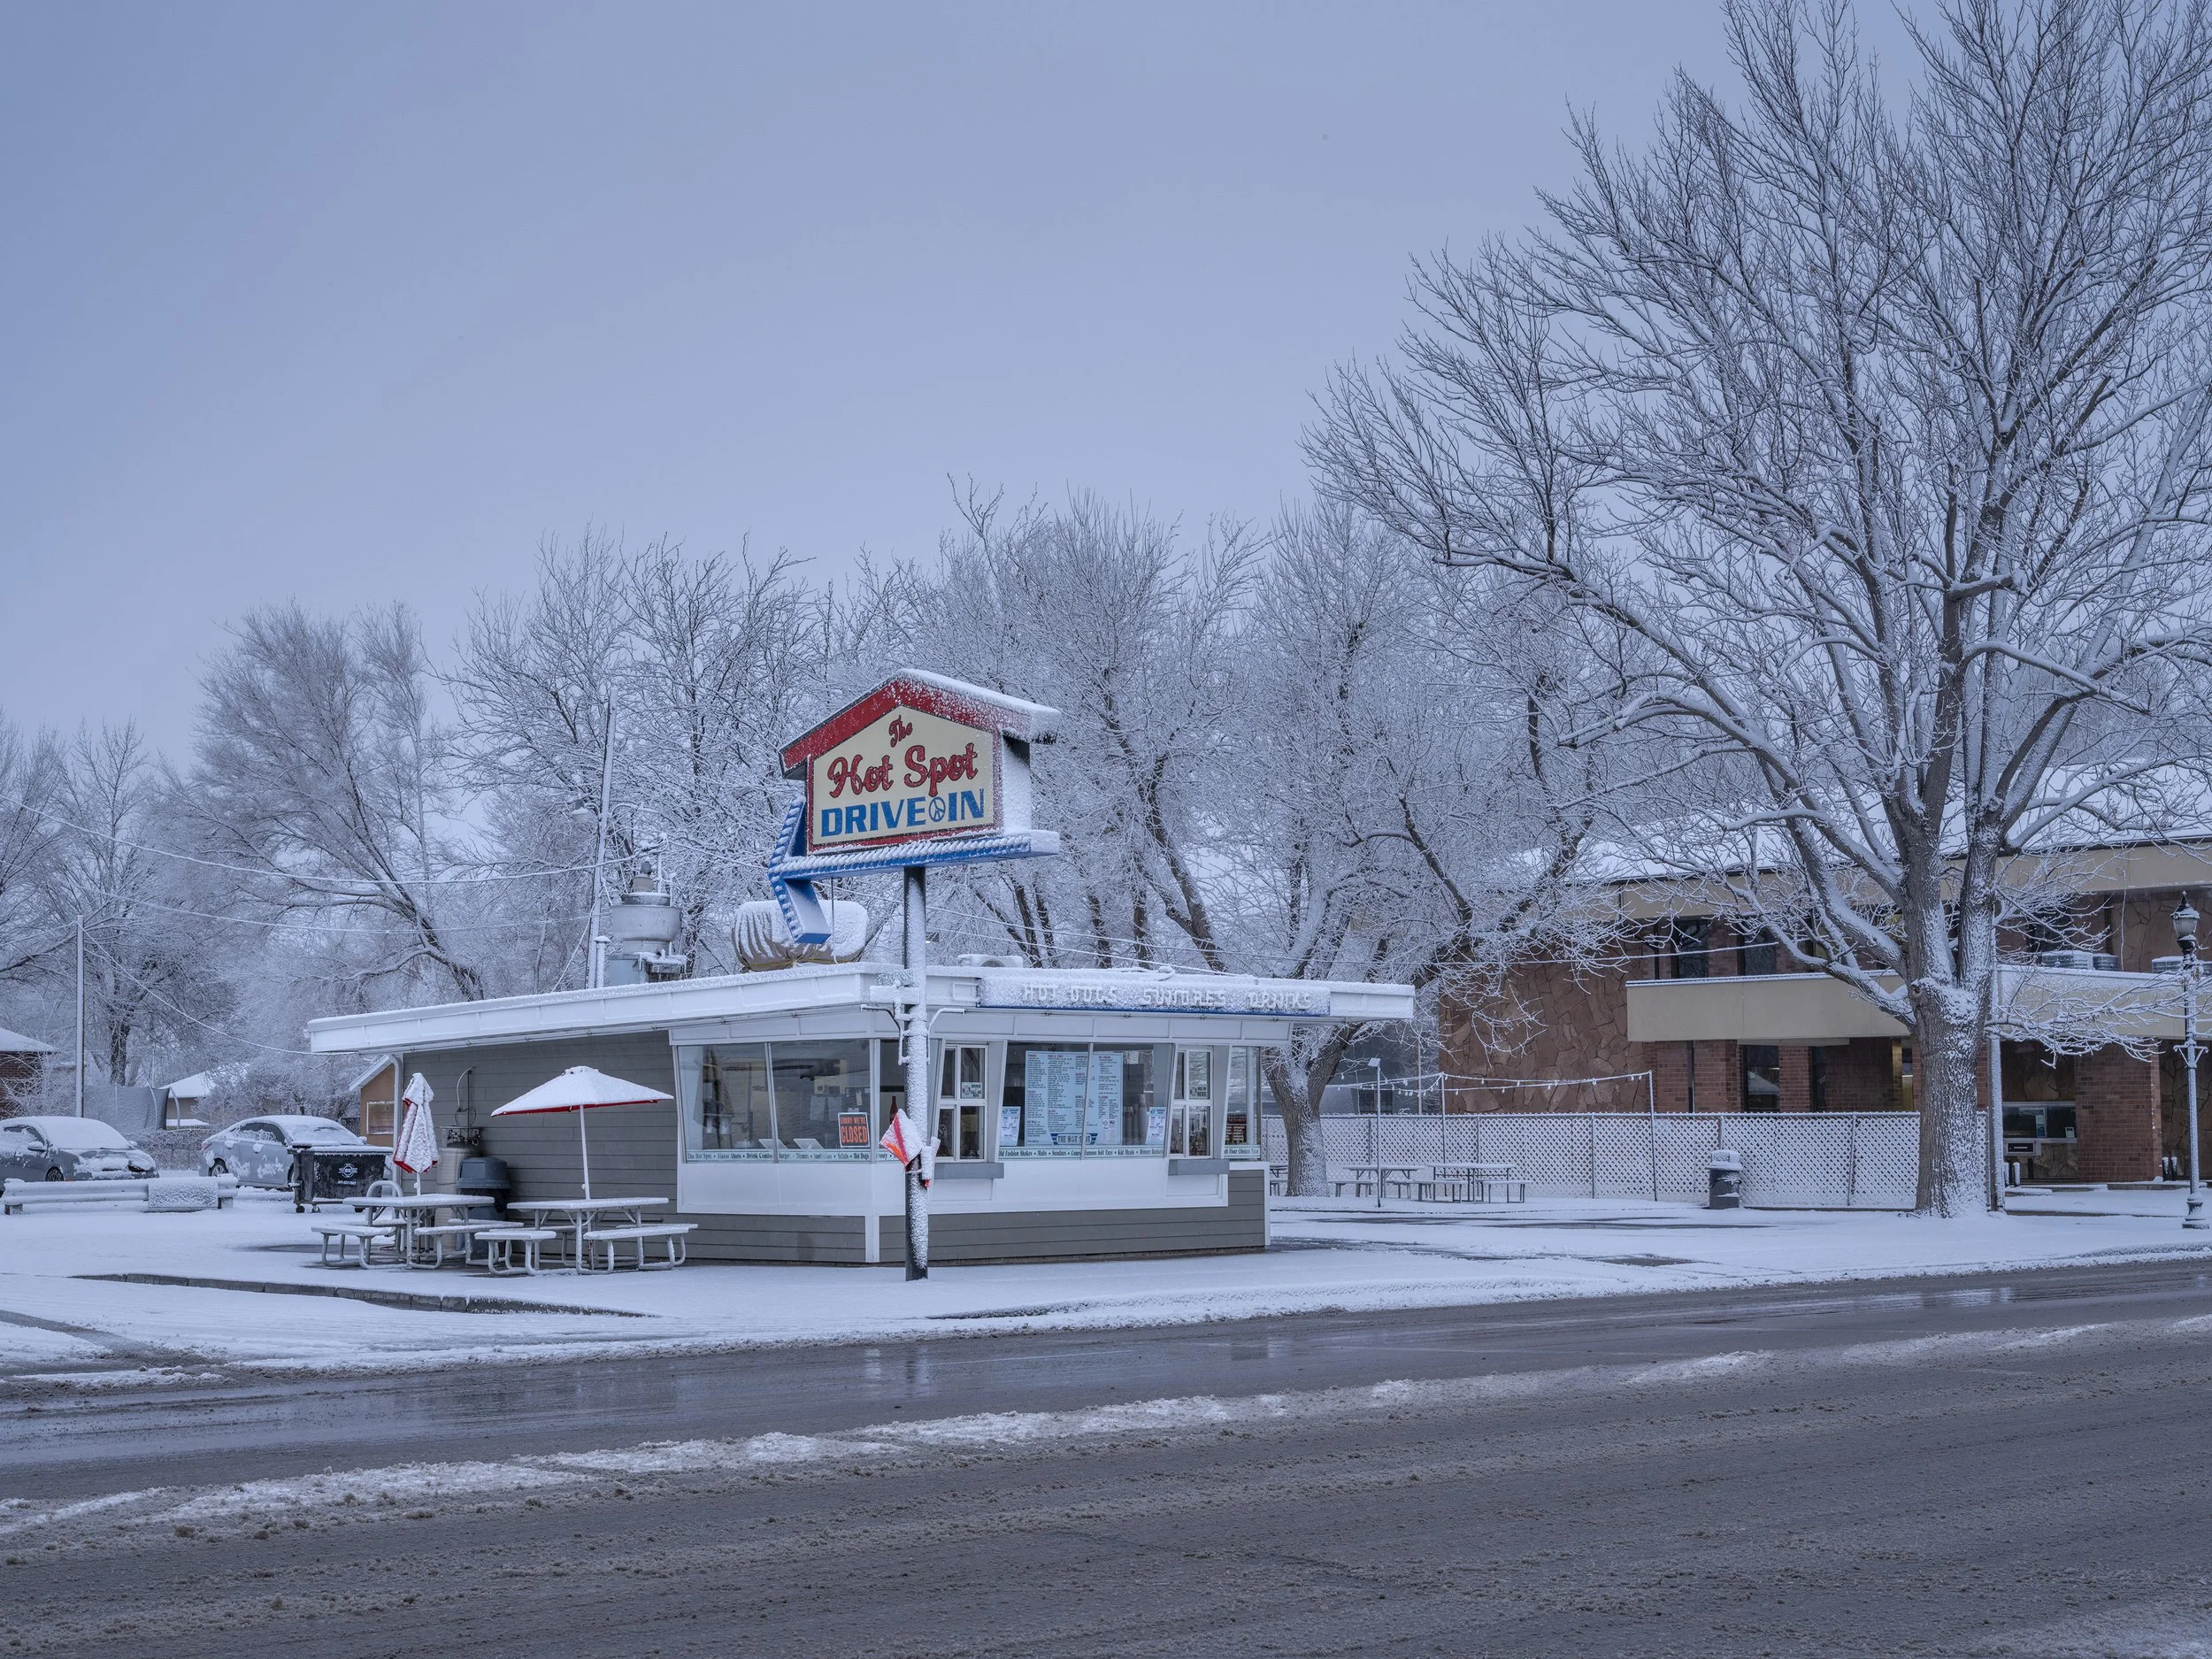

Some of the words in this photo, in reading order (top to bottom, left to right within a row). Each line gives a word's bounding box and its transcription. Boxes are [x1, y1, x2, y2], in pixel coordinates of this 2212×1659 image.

[888, 715, 913, 748] The
[827, 754, 894, 798] Hot
[903, 742, 979, 796] Spot
[821, 796, 926, 837] DRIVE
[948, 788, 985, 822] IN
[1024, 984, 1056, 1002] HOT
[1071, 985, 1118, 1004] DOGS
[1143, 988, 1225, 1007] SUNDAES
[1248, 991, 1311, 1010] DRINKS
[841, 1125, 868, 1143] CLOSED
